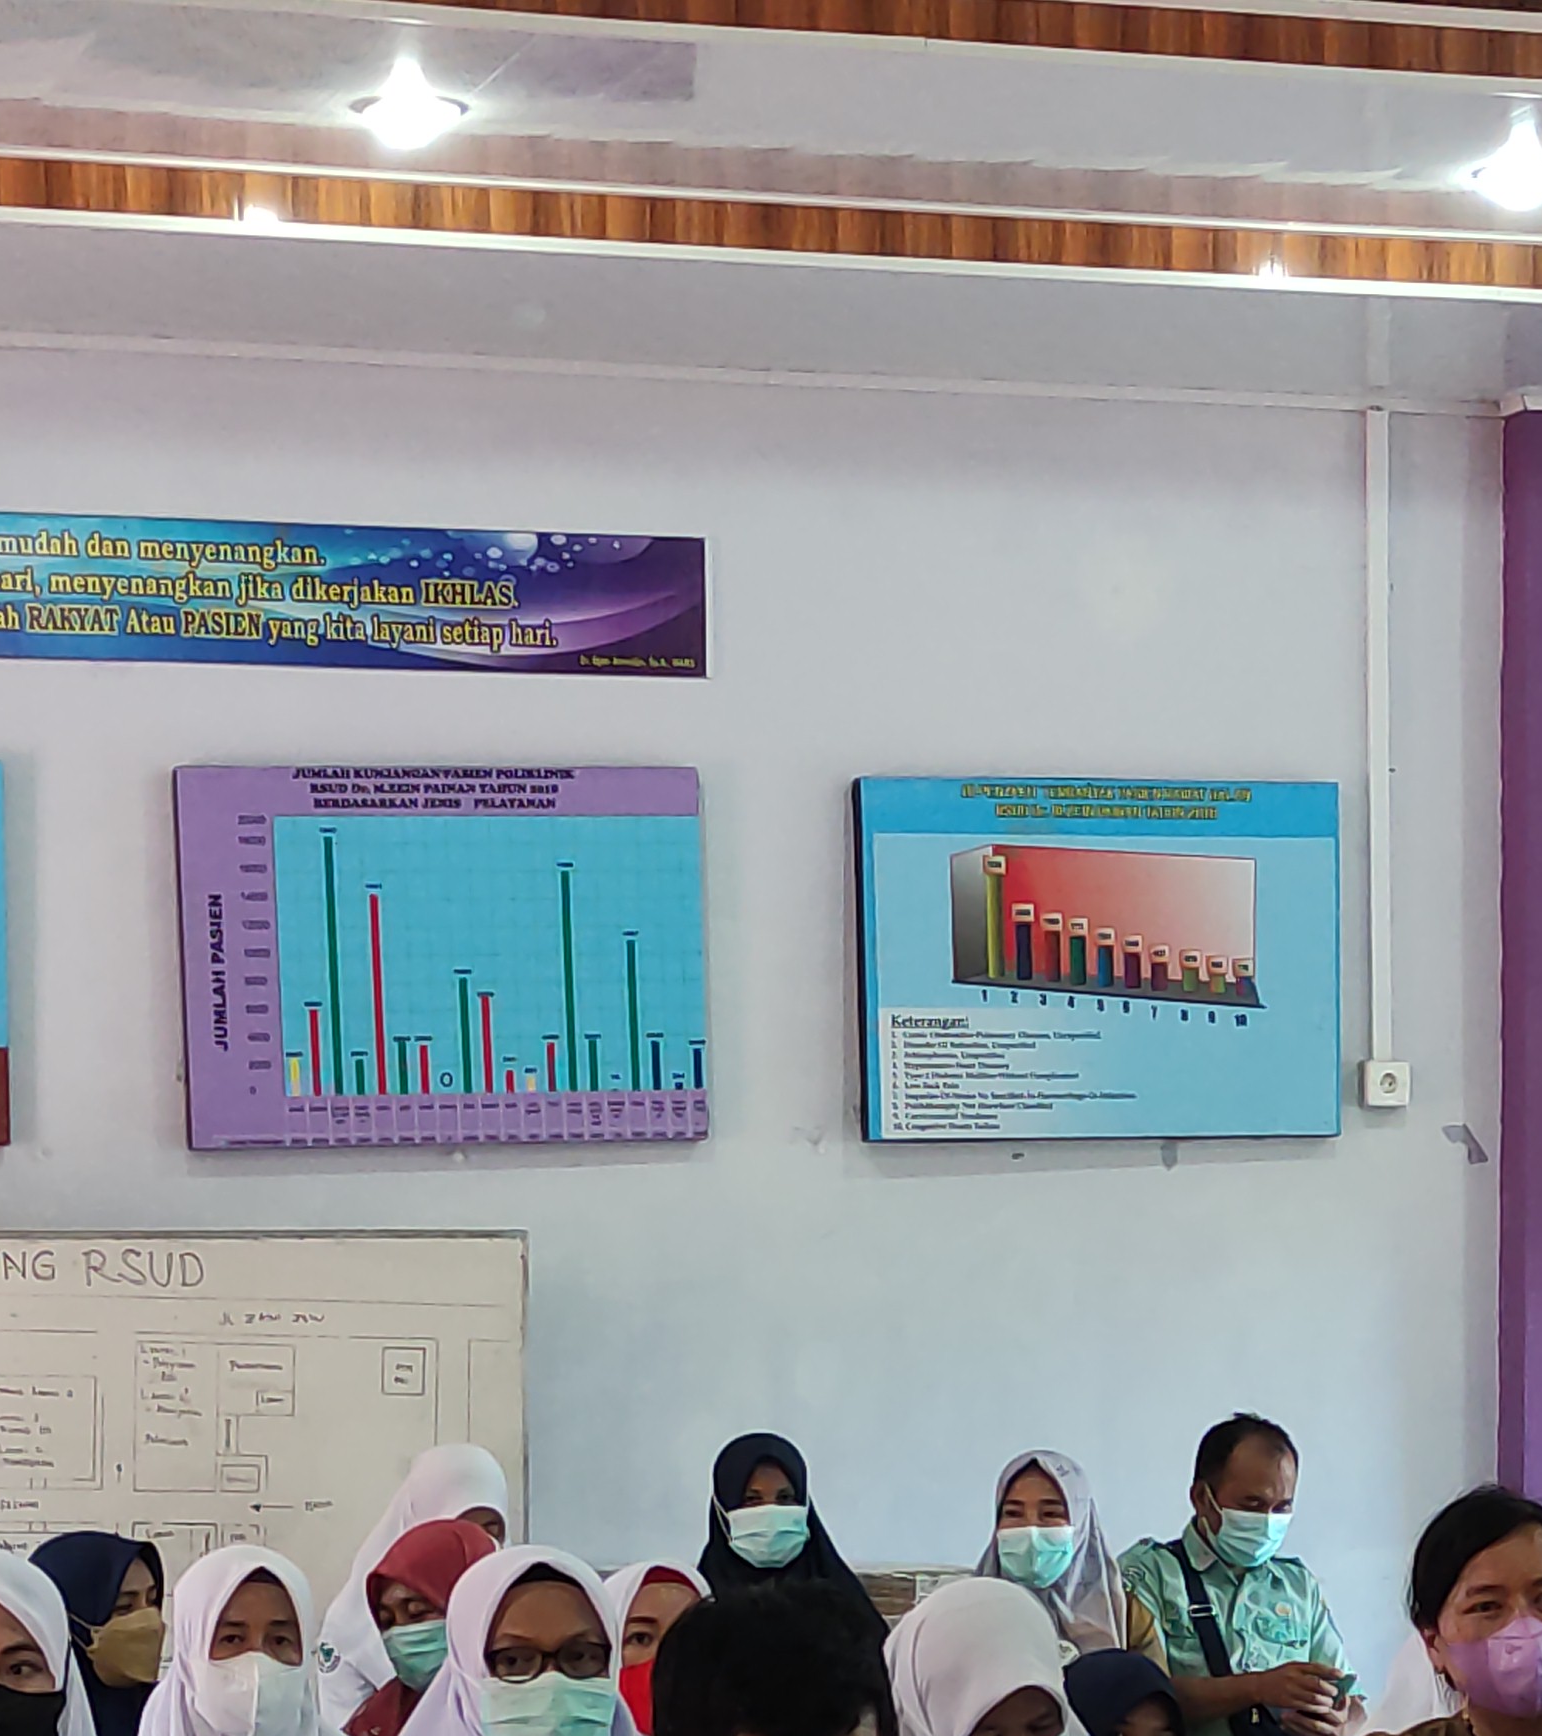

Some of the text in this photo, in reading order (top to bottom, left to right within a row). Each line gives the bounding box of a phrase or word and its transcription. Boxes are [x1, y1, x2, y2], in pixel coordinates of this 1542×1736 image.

[86, 531, 130, 559] dan
[139, 538, 326, 569] menyenangkan.
[49, 573, 231, 602] menyenangkan
[237, 574, 284, 606] jika
[291, 576, 415, 609] dikerjakan
[422, 581, 520, 609] IKHLAS.
[26, 604, 119, 633] RAKYAT
[125, 609, 176, 634] Atau
[182, 610, 262, 638] PASIEN
[267, 617, 319, 646] yang
[324, 614, 366, 641] kita
[372, 617, 435, 648] layani
[441, 619, 505, 651] setiap
[510, 620, 558, 647] hari.
[207, 894, 229, 1052] JUMLAH PASIEN
[81, 1248, 205, 1288] RSUD
